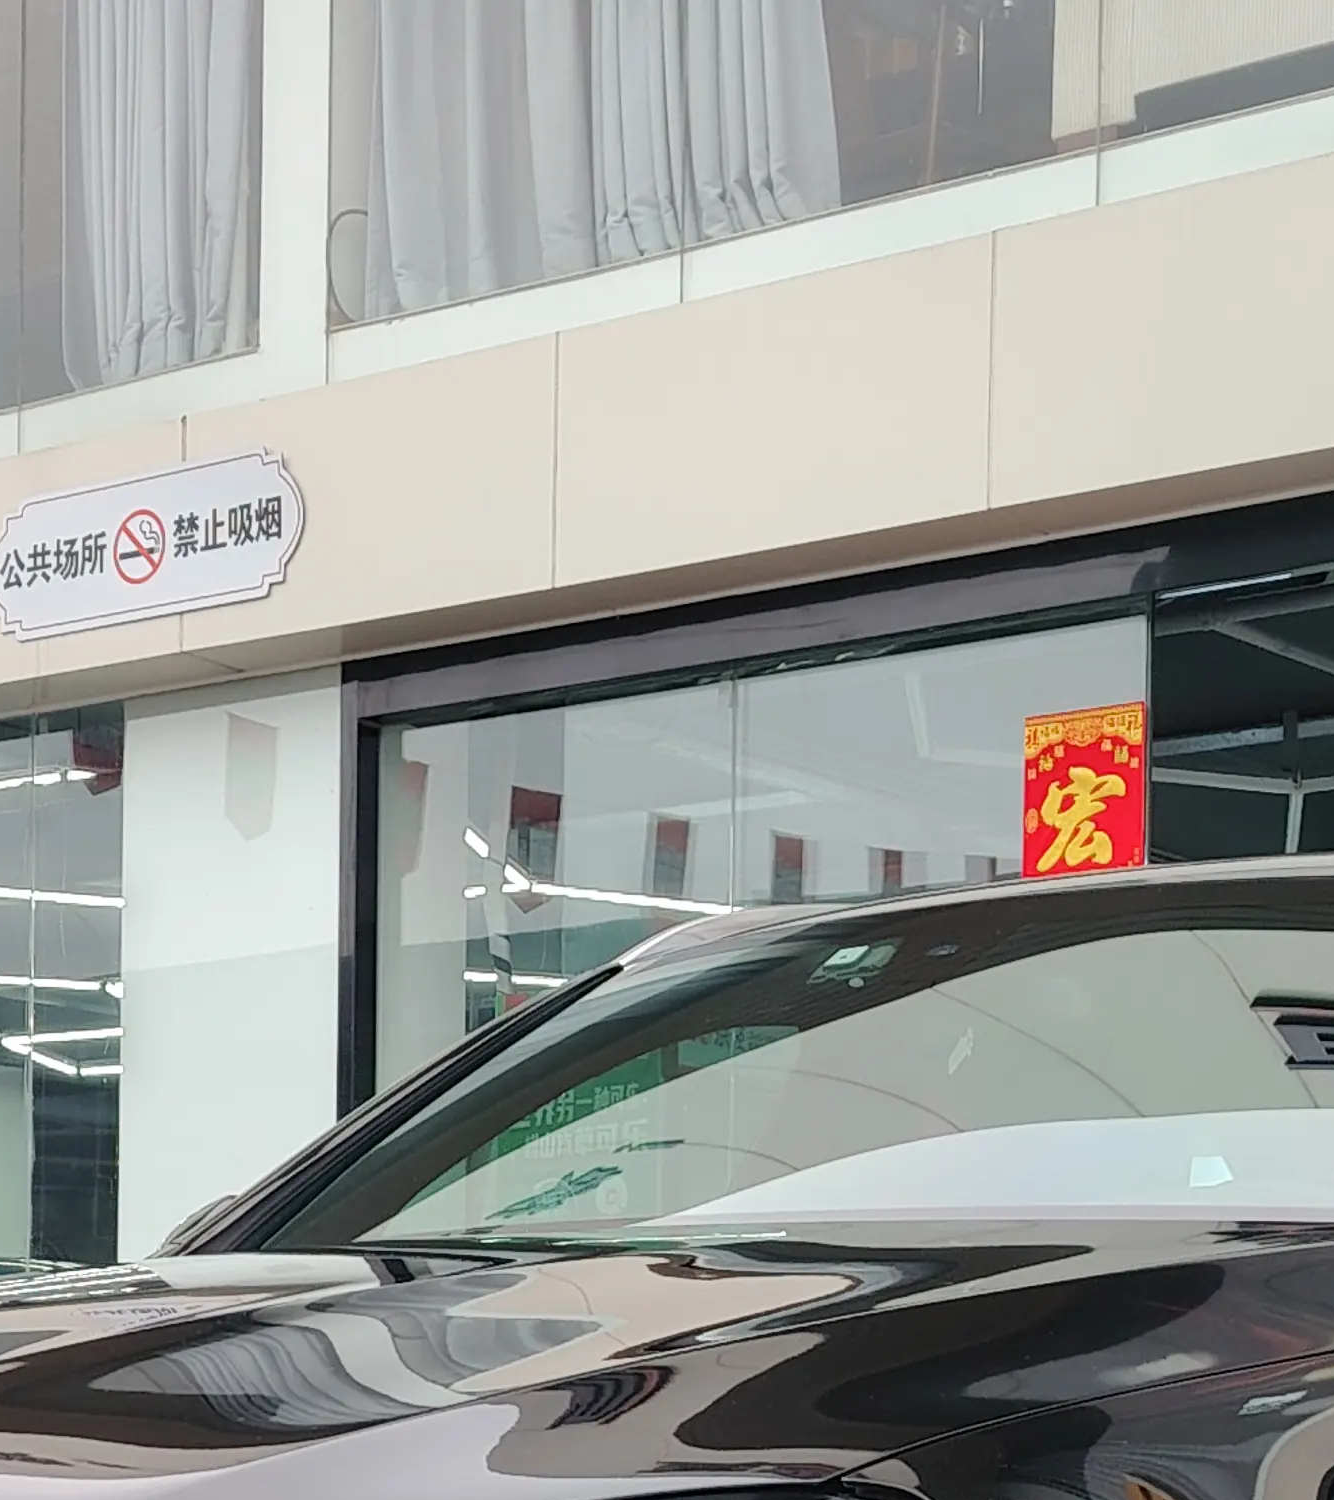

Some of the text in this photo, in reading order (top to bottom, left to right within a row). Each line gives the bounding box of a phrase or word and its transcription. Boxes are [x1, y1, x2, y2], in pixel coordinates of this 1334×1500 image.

[0, 495, 282, 590] 公共场所 禁止吸烟
[1036, 766, 1127, 873] 宏
